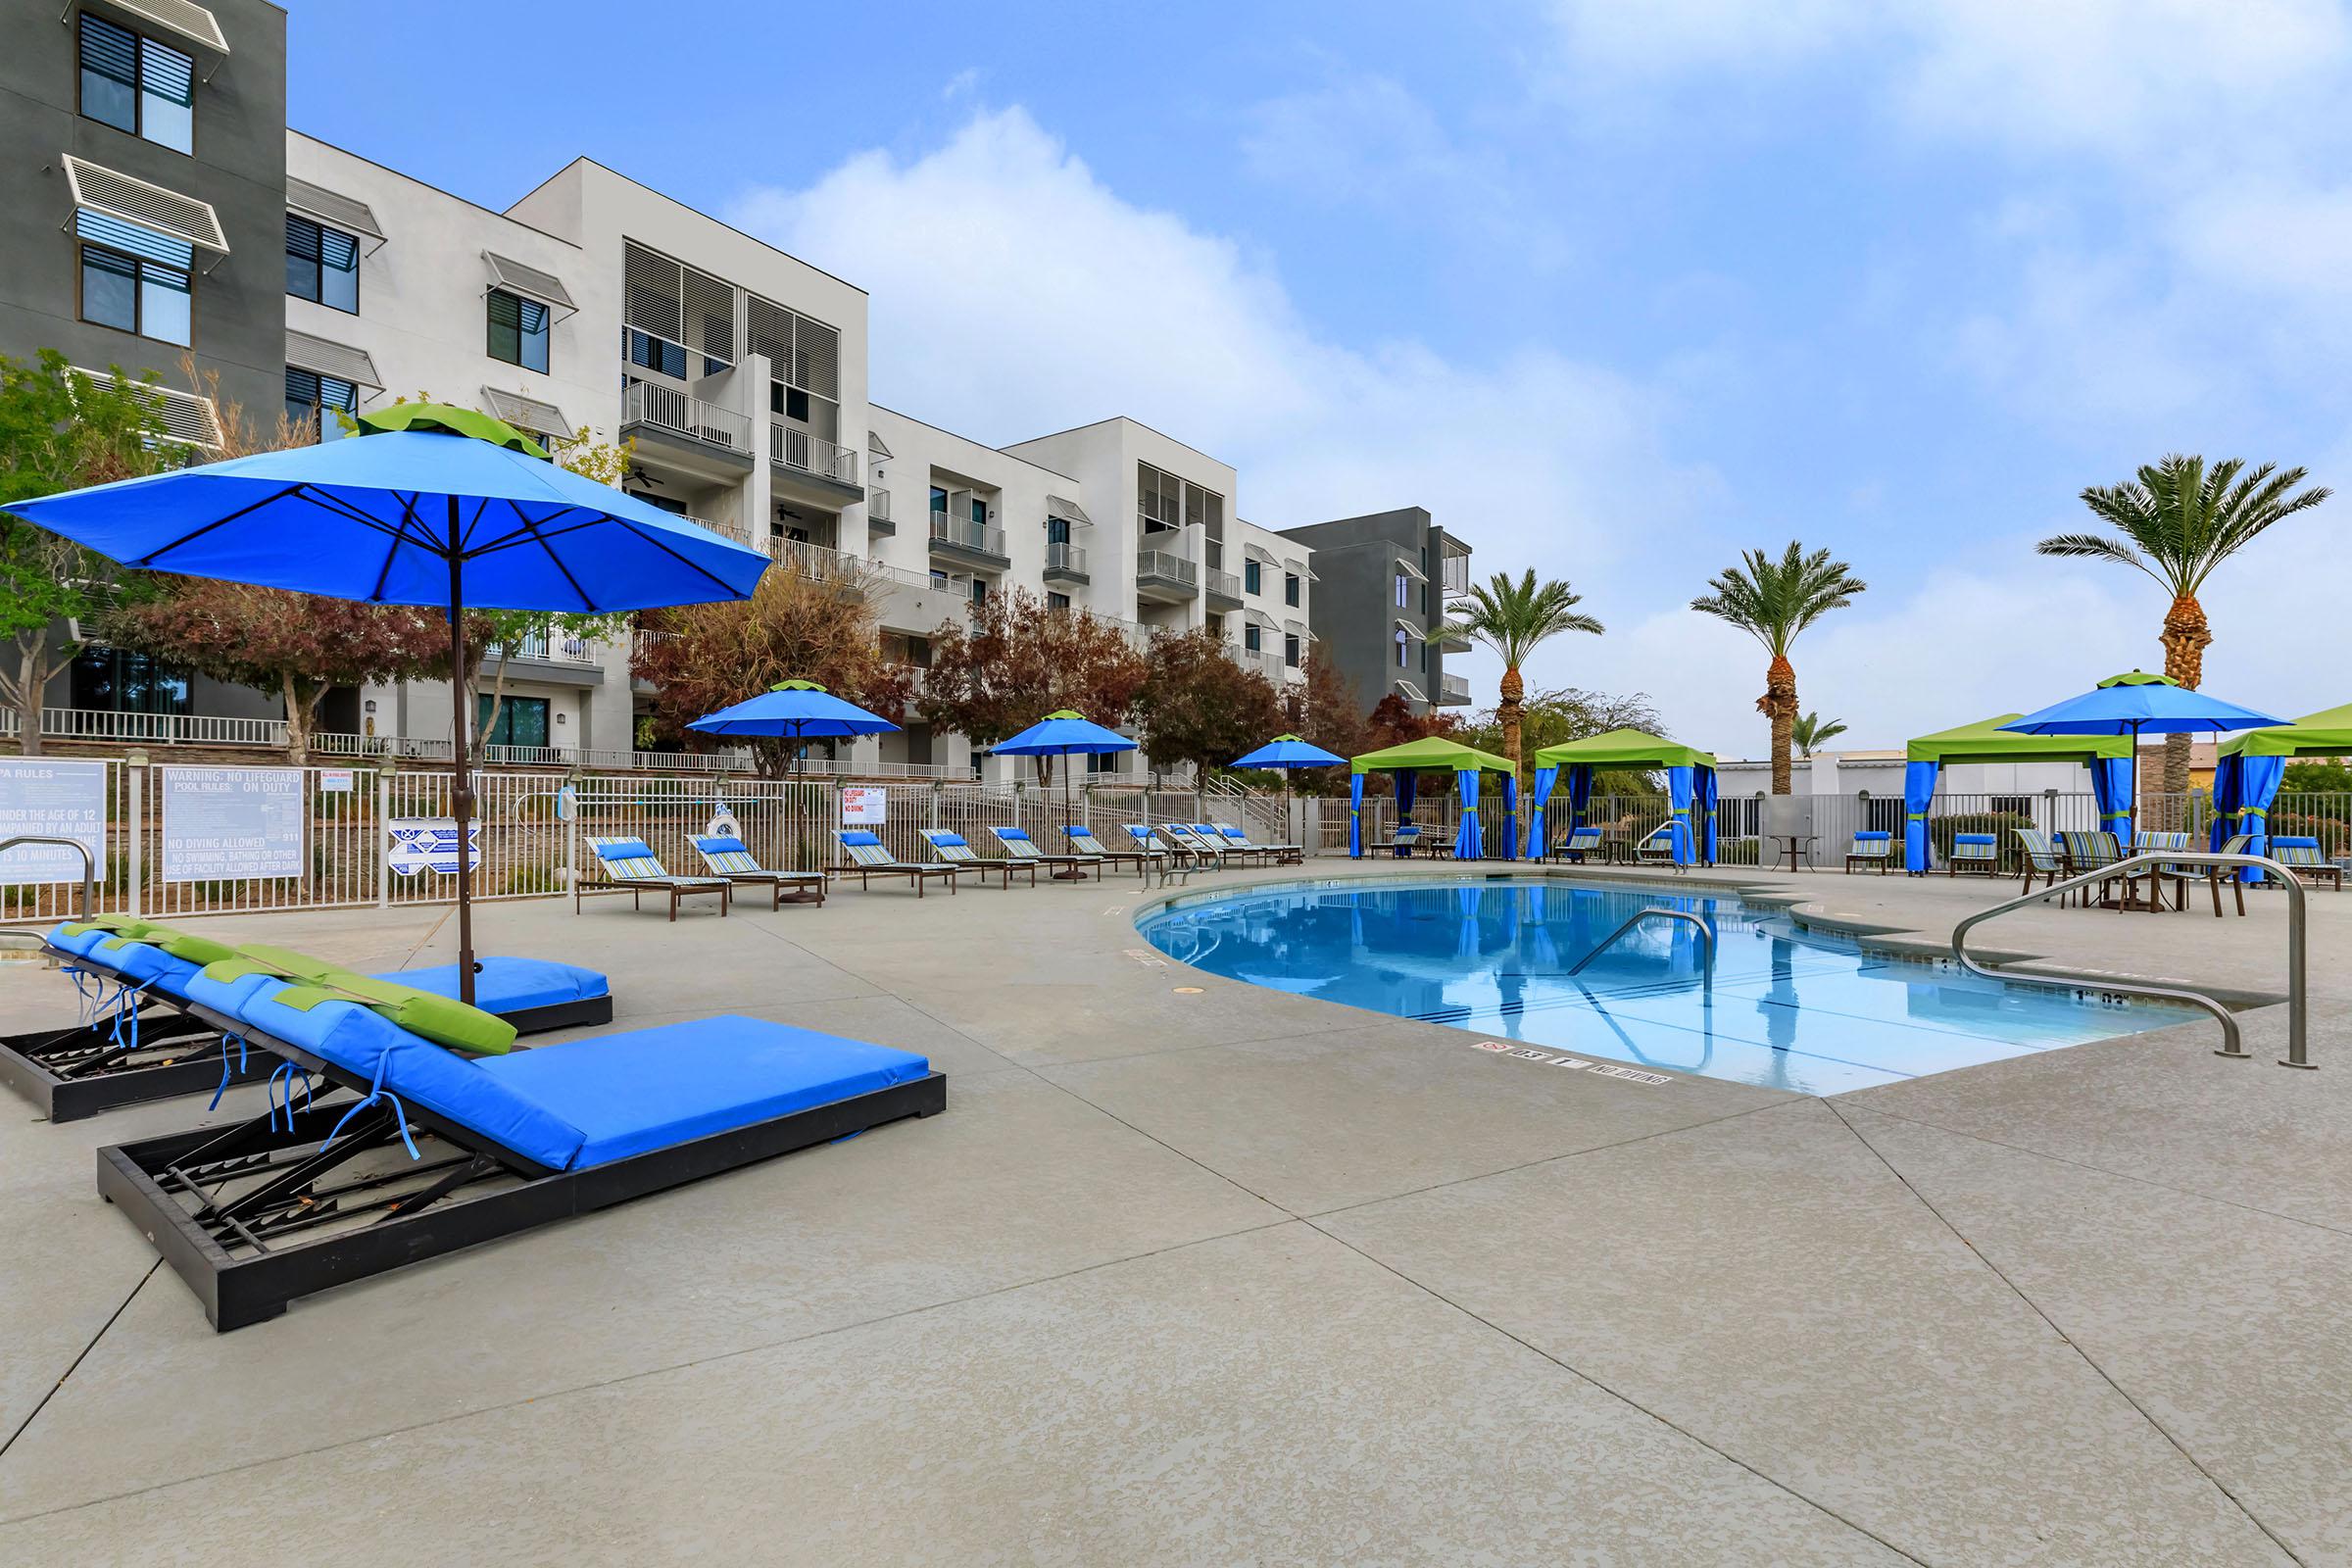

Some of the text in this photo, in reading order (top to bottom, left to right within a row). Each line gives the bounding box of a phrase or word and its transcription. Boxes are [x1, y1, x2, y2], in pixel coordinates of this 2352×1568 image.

[15, 769, 53, 778] RULES
[168, 770, 299, 783] WARNING: NO LIFEGUARD
[174, 782, 234, 792] POOL RULES:
[243, 783, 290, 793] ON DUTY
[0, 808, 95, 821] NDER THE AGE OF 12
[46, 822, 59, 833] BY
[61, 822, 72, 833] AN
[74, 821, 100, 833] ADULT
[168, 837, 266, 850] NO DIVING ALLOWED
[282, 832, 298, 842] 911
[16, 850, 27, 861] 10
[30, 848, 73, 860] MINUTES
[172, 853, 184, 863] NO
[228, 851, 260, 861] BATHING
[262, 851, 271, 860] OR
[274, 850, 297, 860] OTHER
[166, 859, 300, 875] USE OF FACILITY ALLOWED AFTER DARK
[1592, 1065, 1668, 1084] NO DIVING
